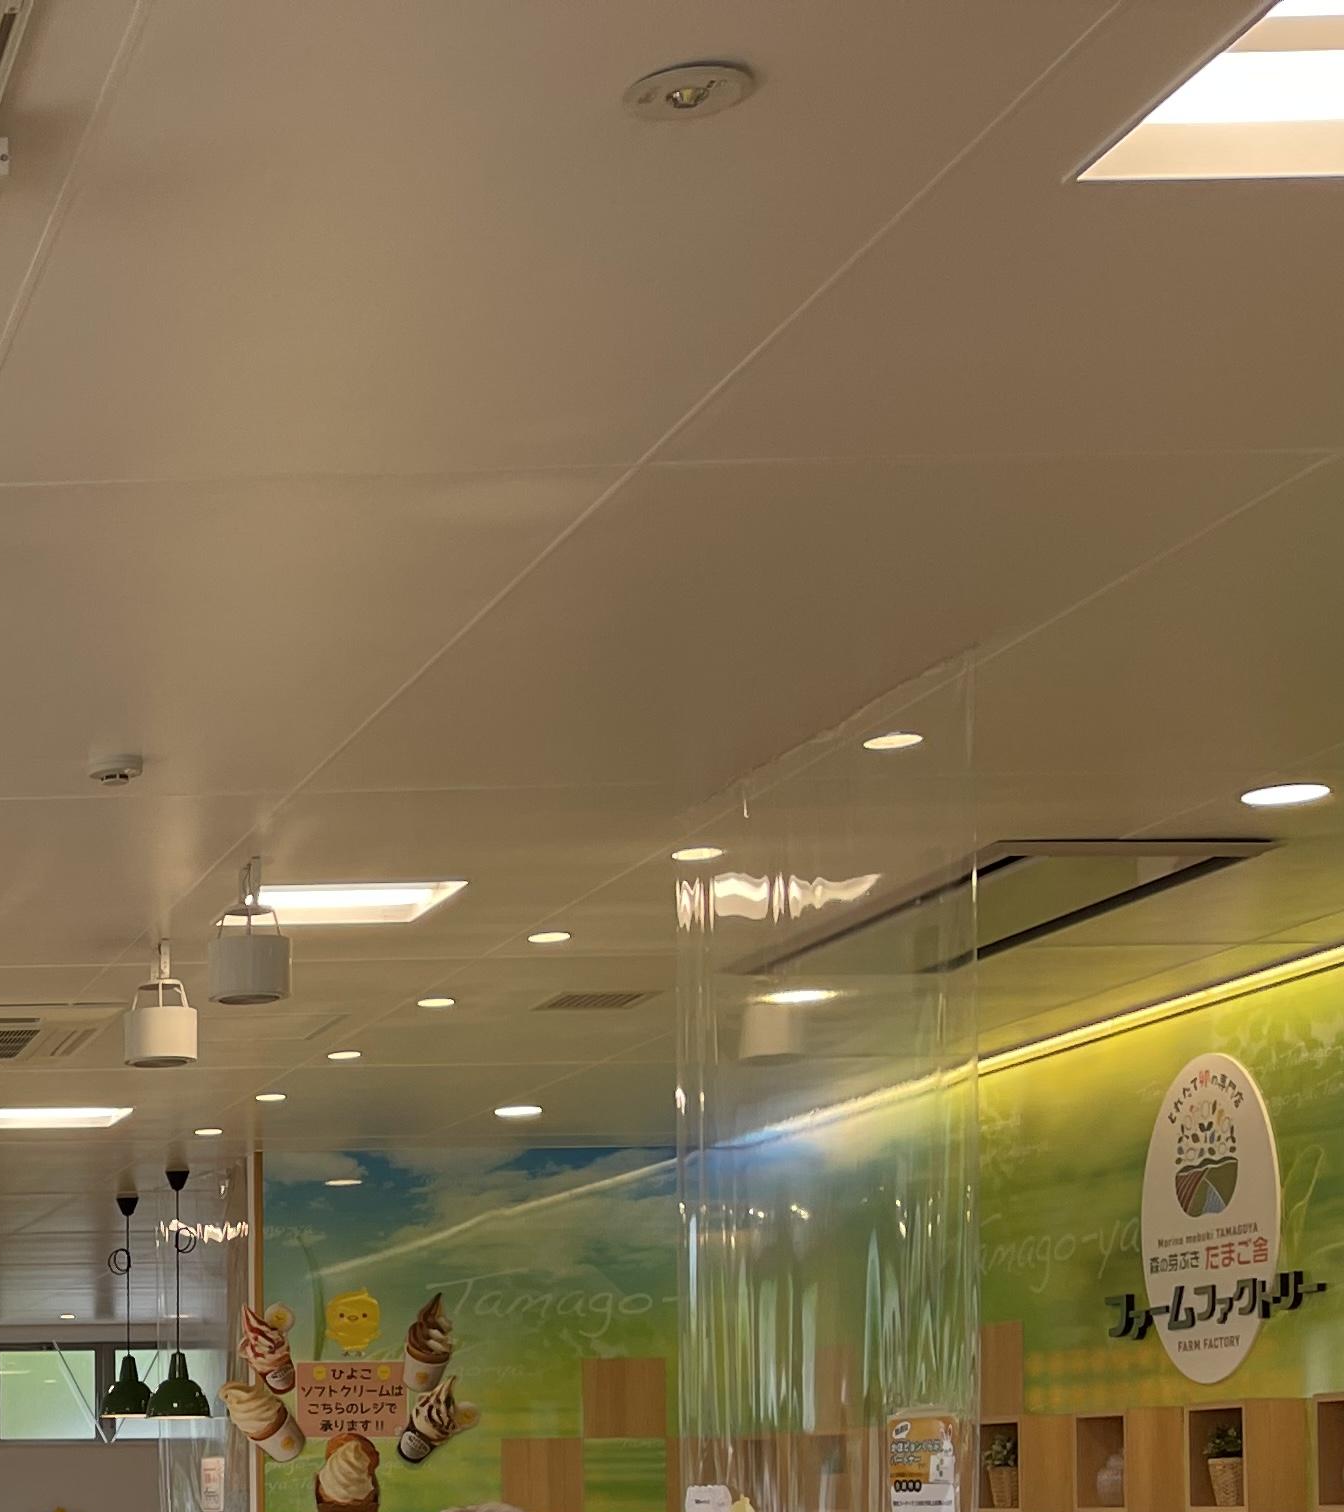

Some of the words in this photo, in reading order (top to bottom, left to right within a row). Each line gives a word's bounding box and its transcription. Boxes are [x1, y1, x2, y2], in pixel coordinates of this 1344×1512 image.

[1149, 1249, 1201, 1275] 森の芽ぶき
[1204, 1236, 1269, 1271] たまご舎
[1105, 1270, 1327, 1340] ファームファクトリー
[1177, 1339, 1202, 1353] FARM
[1203, 1334, 1240, 1351] FACTORY
[331, 1367, 372, 1380] ひよこ
[301, 1385, 404, 1398] ソフトクリームは
[307, 1402, 397, 1415] こちらのレジで
